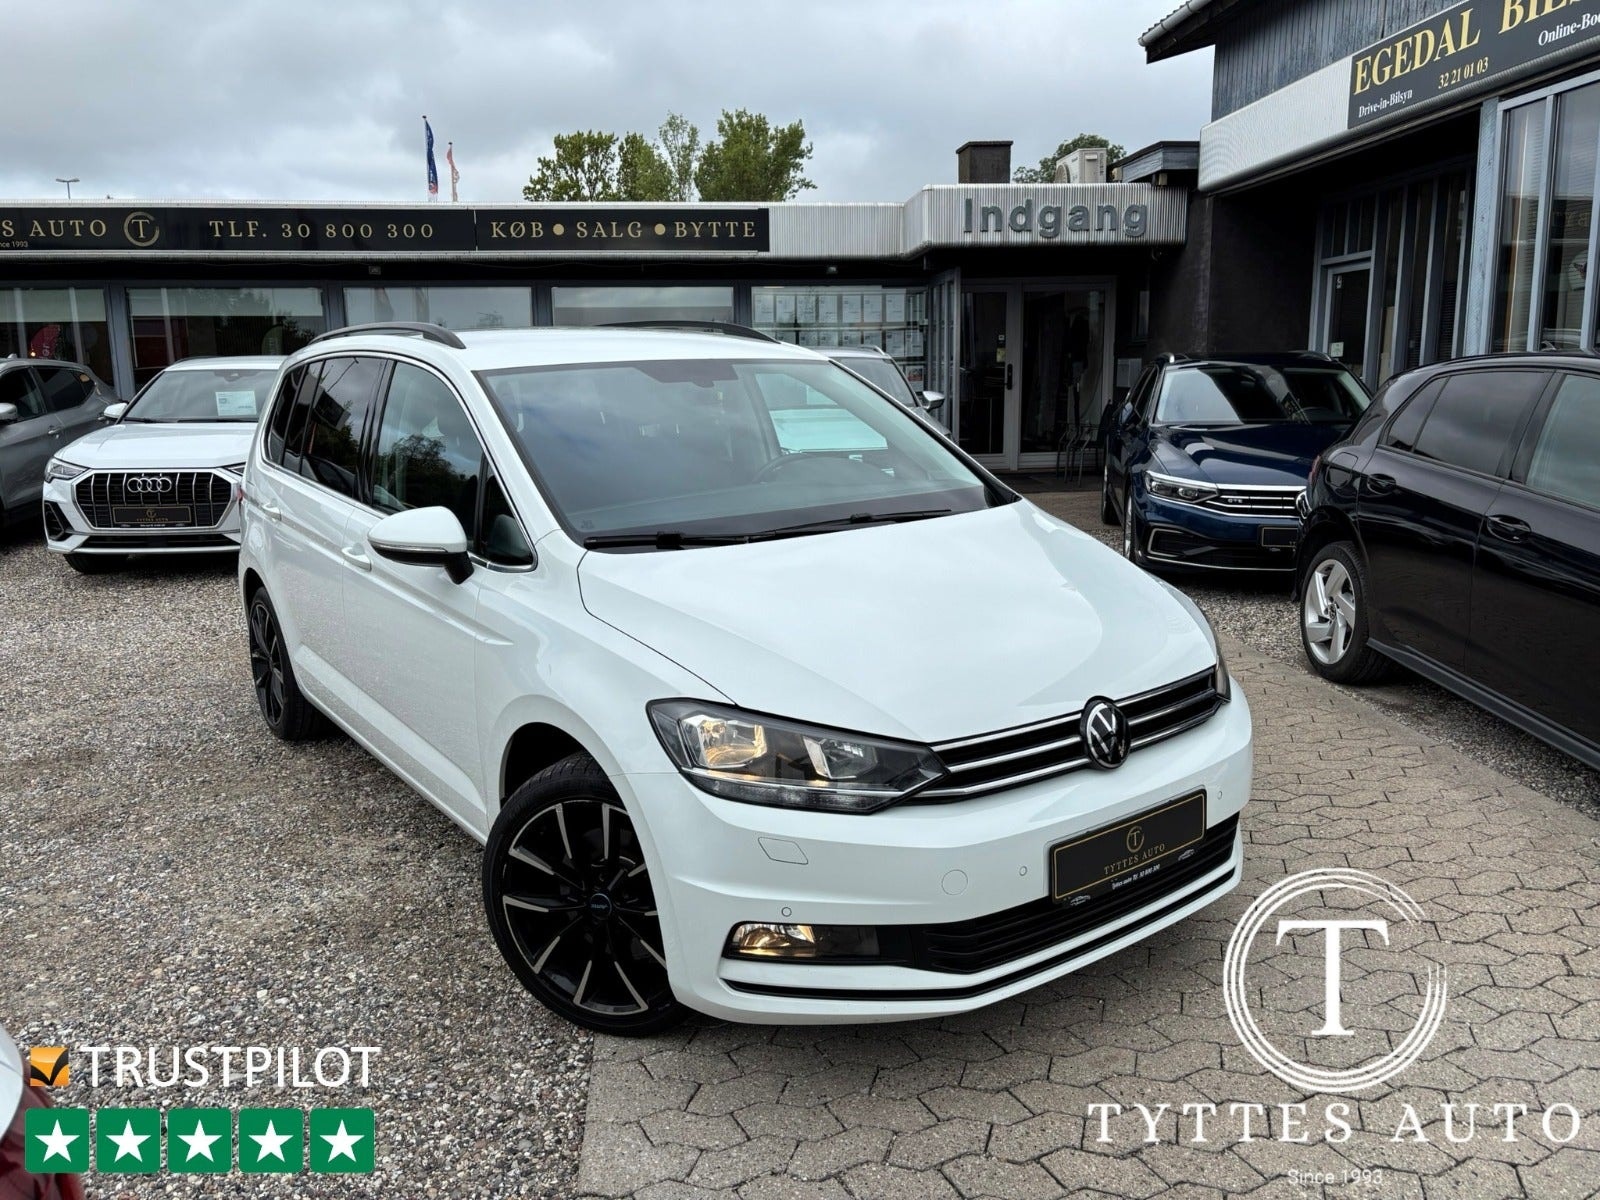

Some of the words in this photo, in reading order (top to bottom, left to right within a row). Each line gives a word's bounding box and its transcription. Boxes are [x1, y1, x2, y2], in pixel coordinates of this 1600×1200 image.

[1538, 13, 1600, 46] Online-Bo
[1353, 8, 1481, 95] EGEDAL
[1438, 72, 1449, 89] 32
[1450, 67, 1461, 84] 21
[1464, 62, 1474, 79] 01
[1477, 56, 1489, 74] 03
[1358, 89, 1413, 118] Drive-in-Bilsyn
[29, 219, 107, 237] AUTO
[209, 220, 268, 238] TLF.
[281, 223, 311, 238] 30
[325, 223, 373, 239] 800
[387, 223, 434, 239] 300
[490, 221, 545, 238] KØB
[576, 221, 643, 238] SALG
[674, 220, 756, 238] BYTTE
[963, 198, 1147, 239] Indgang
[12, 240, 29, 248] 1993
[1104, 855, 1139, 874] TYTTES
[1142, 843, 1165, 860] AUTO
